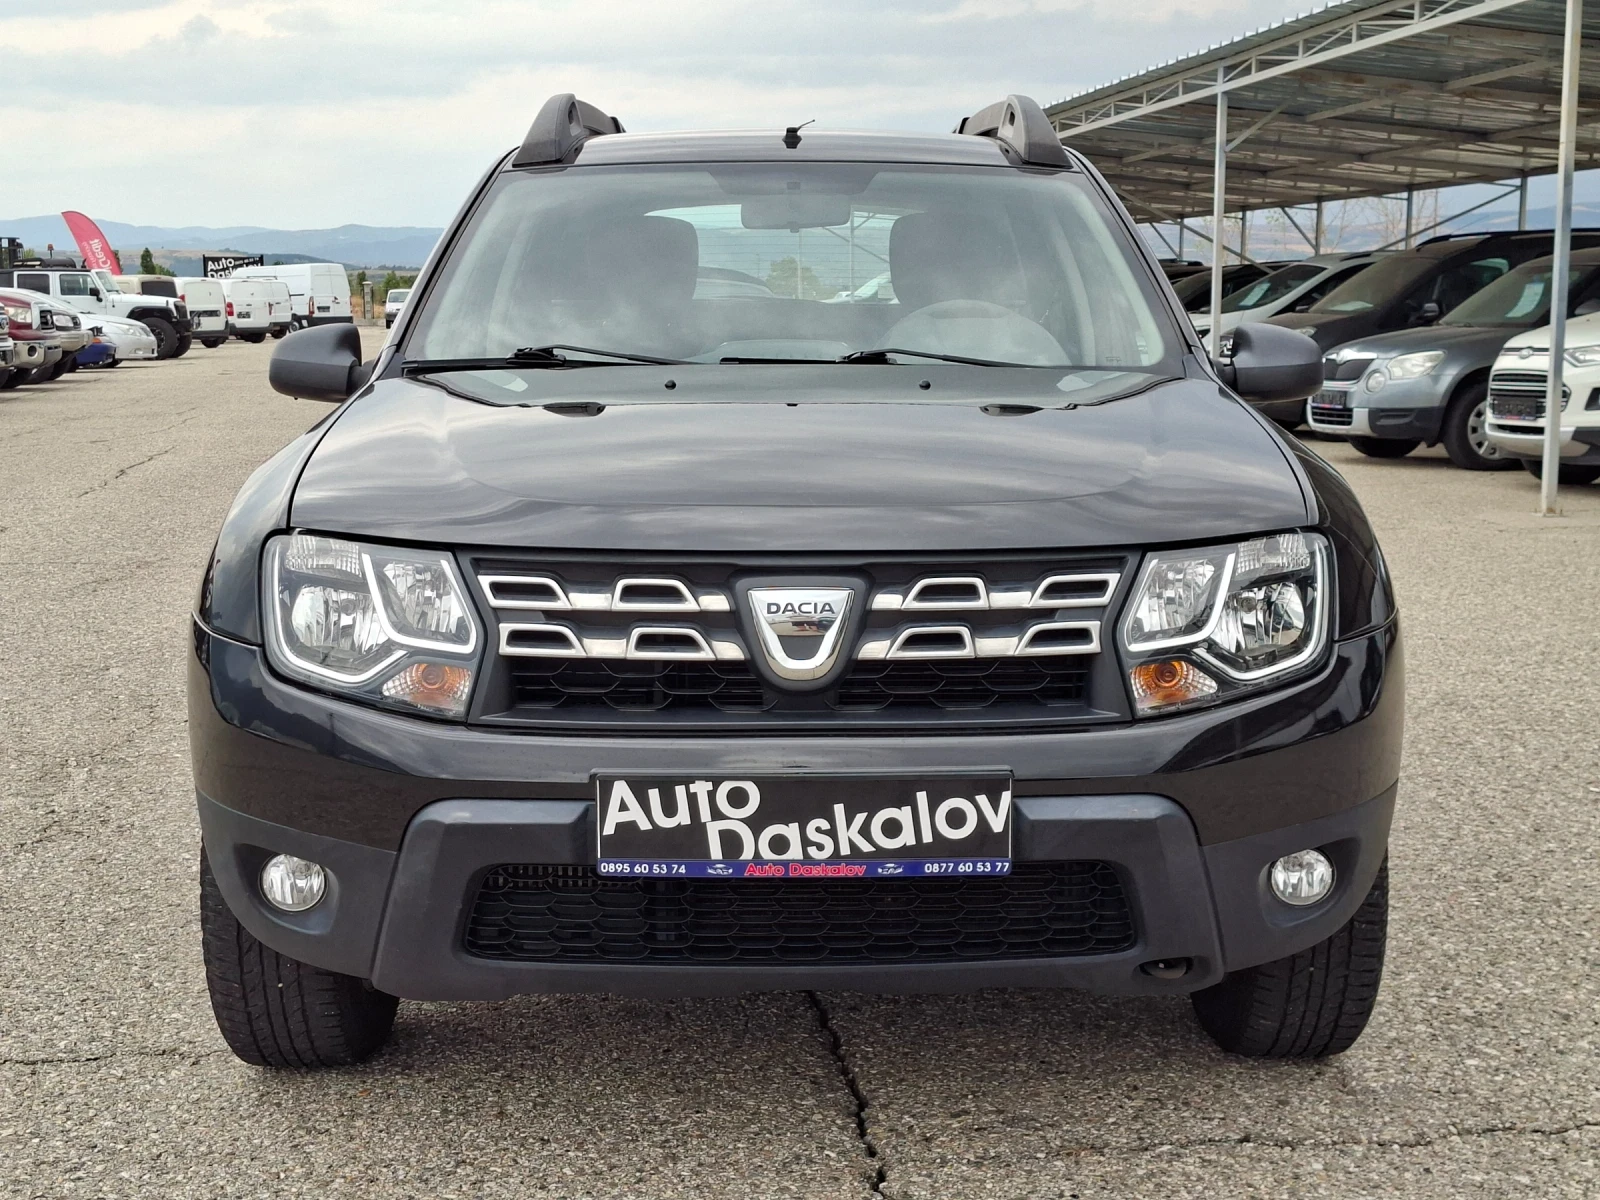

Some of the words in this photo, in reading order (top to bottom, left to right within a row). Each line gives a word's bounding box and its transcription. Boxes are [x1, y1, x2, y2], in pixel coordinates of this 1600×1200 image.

[208, 258, 235, 271] Auto
[766, 602, 835, 614] DACIA
[603, 780, 760, 836] Auto
[706, 791, 1011, 859] Daskalov
[600, 862, 630, 873] 0895
[634, 863, 649, 873] 60
[652, 863, 667, 873] 53
[671, 864, 686, 874] 74
[744, 863, 785, 876] Auto
[789, 863, 866, 876] Daskalov
[924, 863, 954, 873] 0877
[957, 862, 973, 872] 60
[976, 862, 991, 872] 53
[995, 862, 1010, 872] 77
